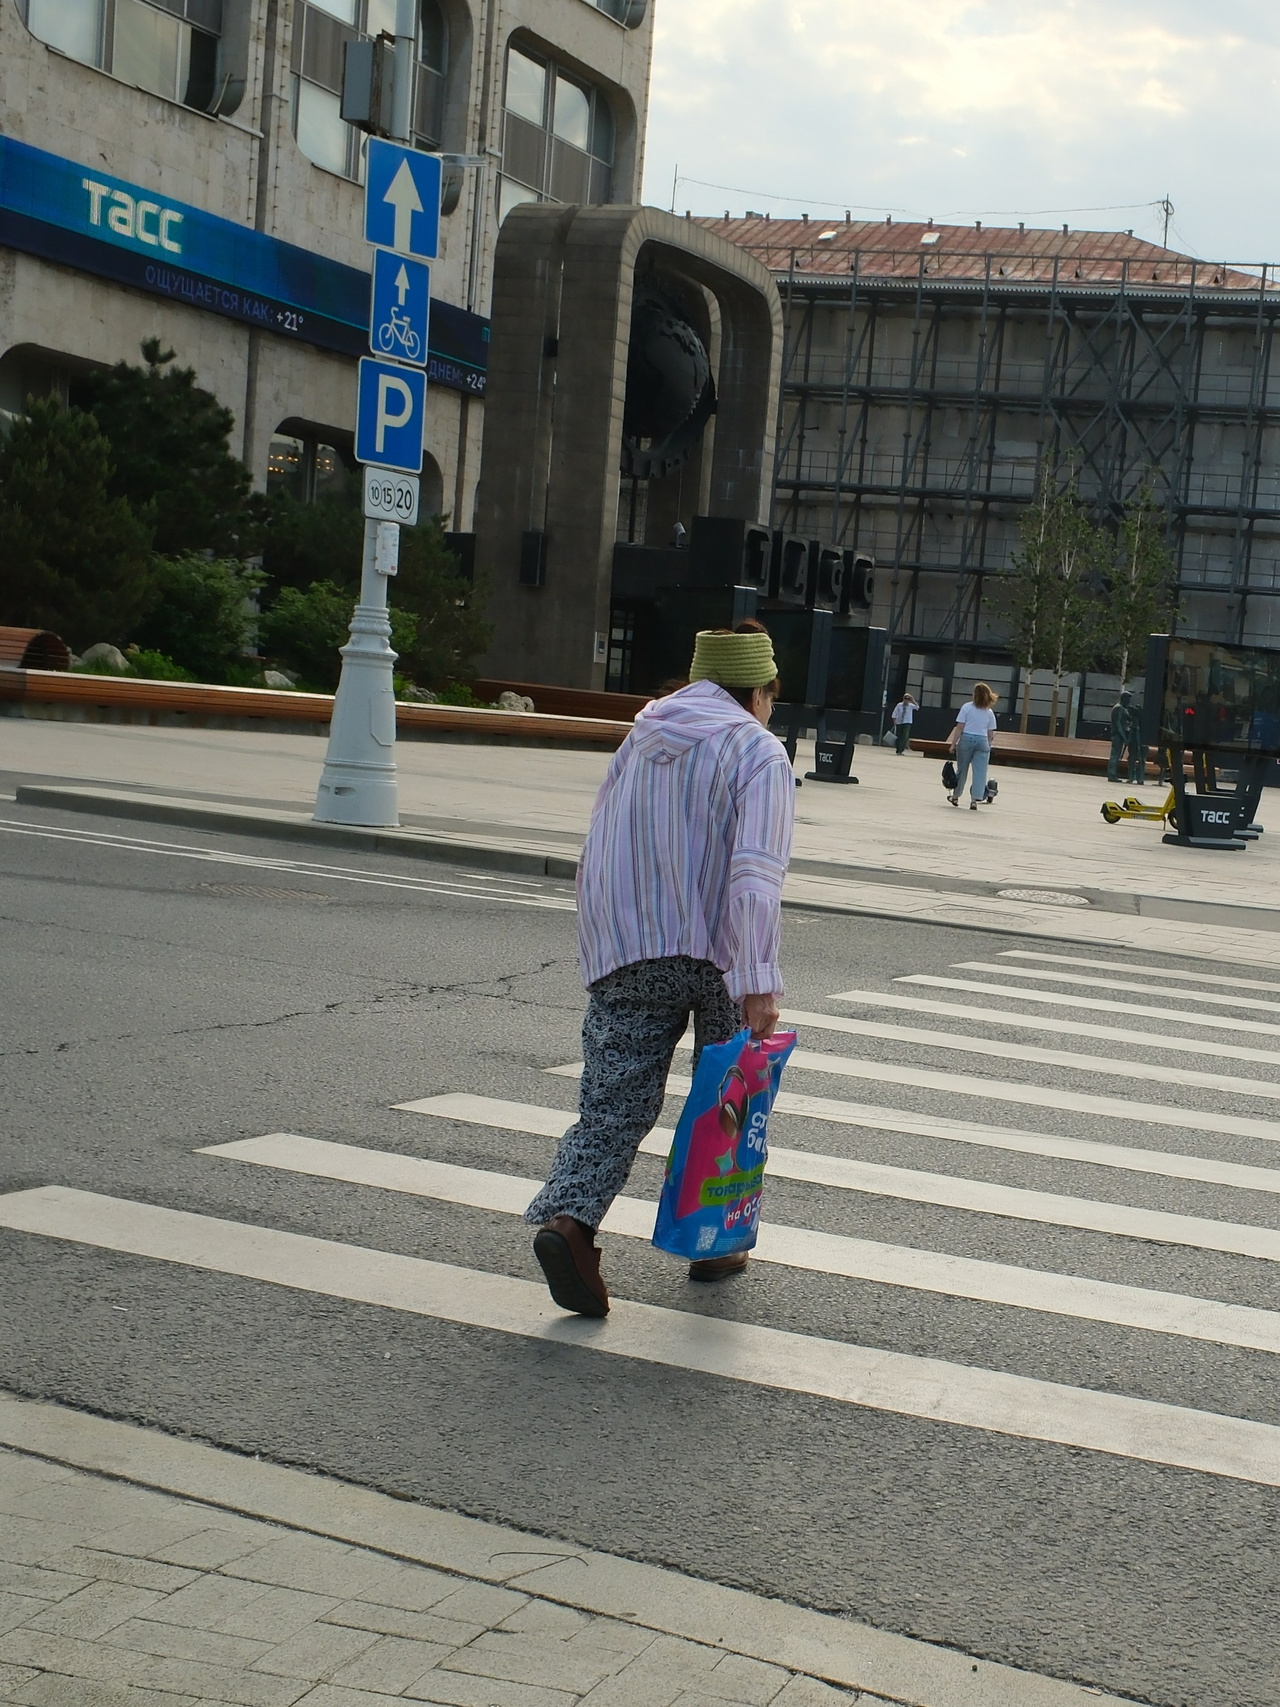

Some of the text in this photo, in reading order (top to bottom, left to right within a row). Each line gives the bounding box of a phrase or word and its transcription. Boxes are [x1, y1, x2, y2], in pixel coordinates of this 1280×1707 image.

[145, 265, 239, 309] ОЩУЩАЕТСЯ
[276, 311, 304, 331] +21°
[376, 373, 413, 453] P
[371, 486, 412, 510] 10 15 20
[727, 1210, 740, 1221] на
